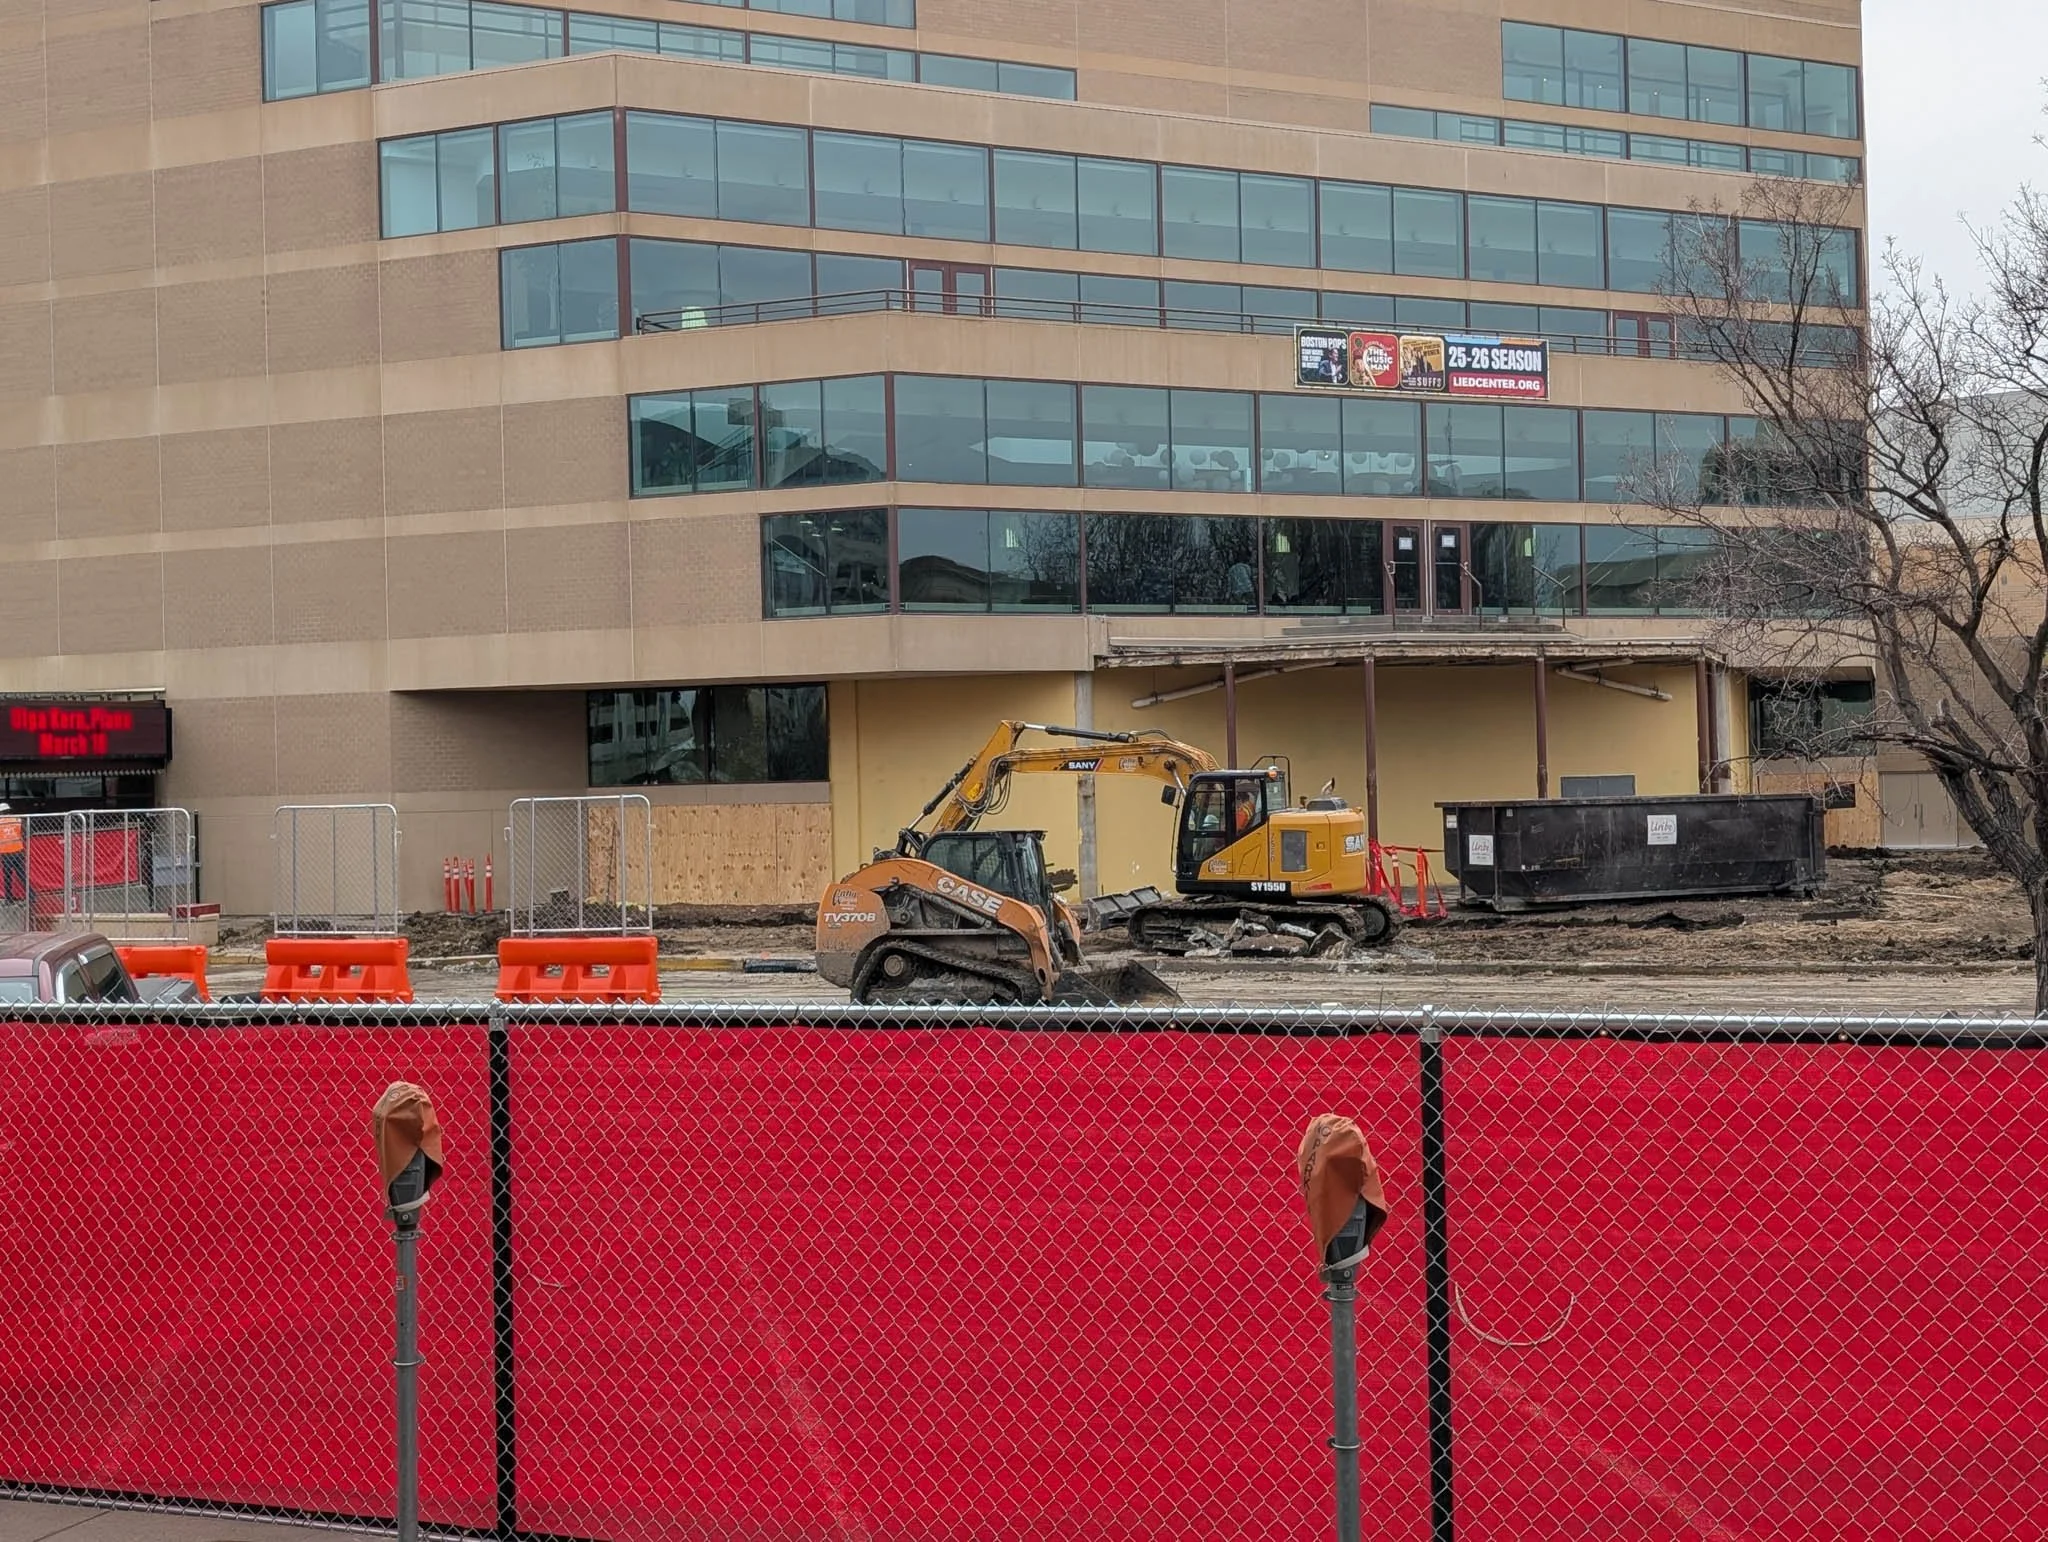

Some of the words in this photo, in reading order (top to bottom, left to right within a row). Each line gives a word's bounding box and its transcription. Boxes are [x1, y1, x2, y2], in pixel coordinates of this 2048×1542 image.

[1301, 336, 1327, 348] BOSTON
[1328, 338, 1346, 349] POPS
[1369, 348, 1385, 356] THE
[1366, 356, 1393, 364] MUSIC
[1448, 346, 1489, 369] 25-26
[1491, 348, 1542, 372] SEASON
[1370, 363, 1389, 371] MAN
[1416, 376, 1442, 388] SUFFS
[1453, 376, 1540, 391] LIEDCENTER.ORG
[11, 707, 47, 732] Olga
[40, 732, 88, 756] March
[1068, 761, 1096, 769] SANY
[1250, 881, 1286, 892] SY155U
[937, 877, 1003, 914] CASE
[823, 912, 876, 922] TV370B
